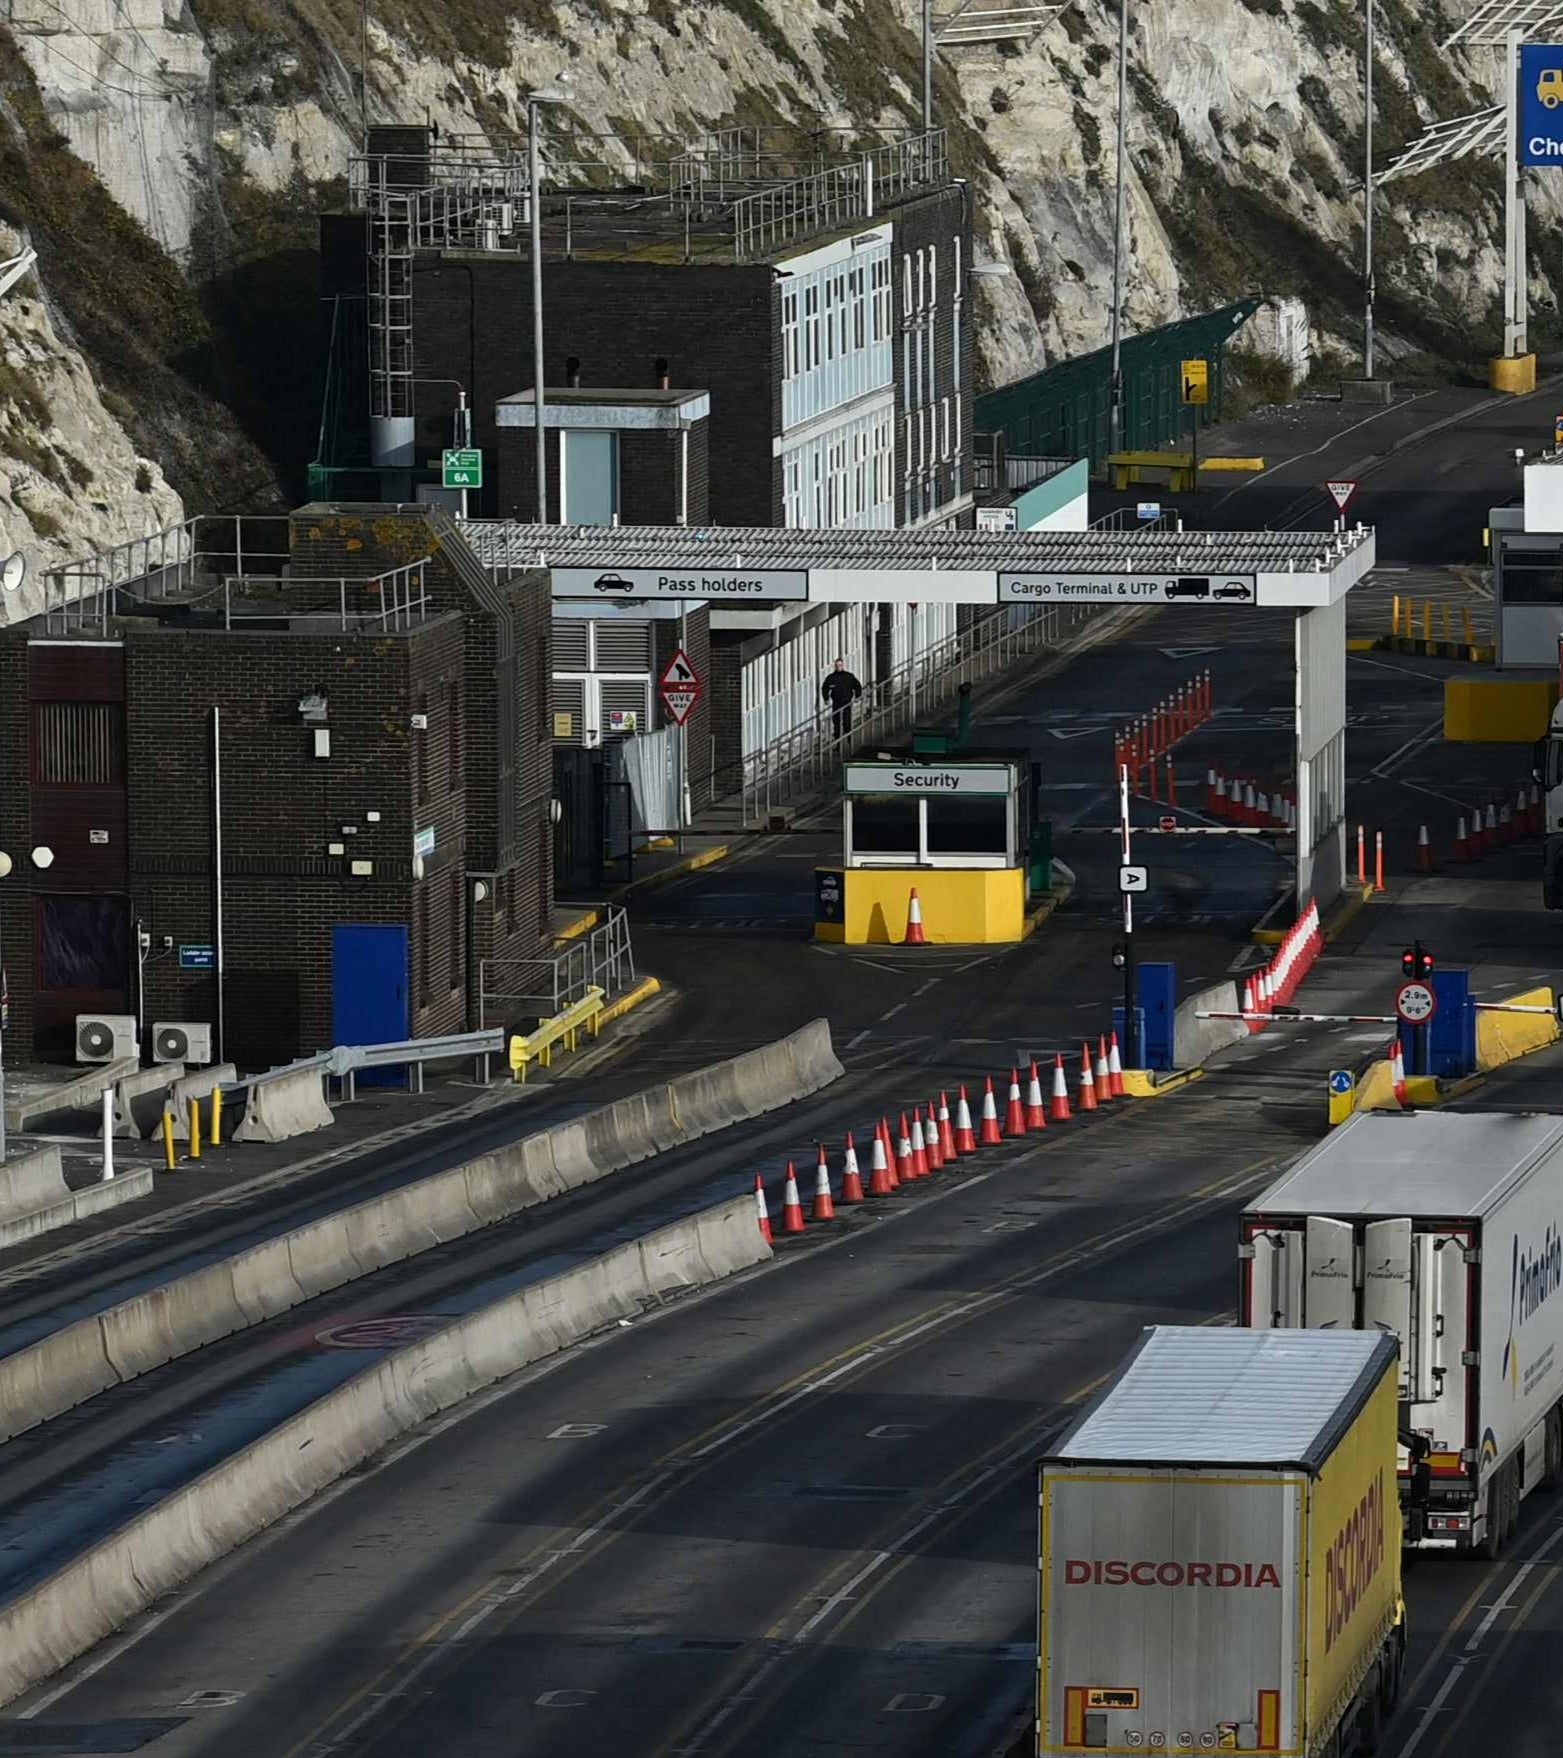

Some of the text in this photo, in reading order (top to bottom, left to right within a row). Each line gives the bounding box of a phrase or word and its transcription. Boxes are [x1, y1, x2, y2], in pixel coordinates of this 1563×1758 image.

[454, 472, 470, 482] 6A
[658, 577, 763, 592] Pass holders
[1011, 582, 1158, 596] Cargo Terminal & UTP
[668, 694, 691, 702] GIVE
[894, 773, 960, 789] Security
[1126, 873, 1140, 885] A
[1325, 1466, 1384, 1657] DISCORDIA
[1065, 1560, 1281, 1587] DISCORDIA
